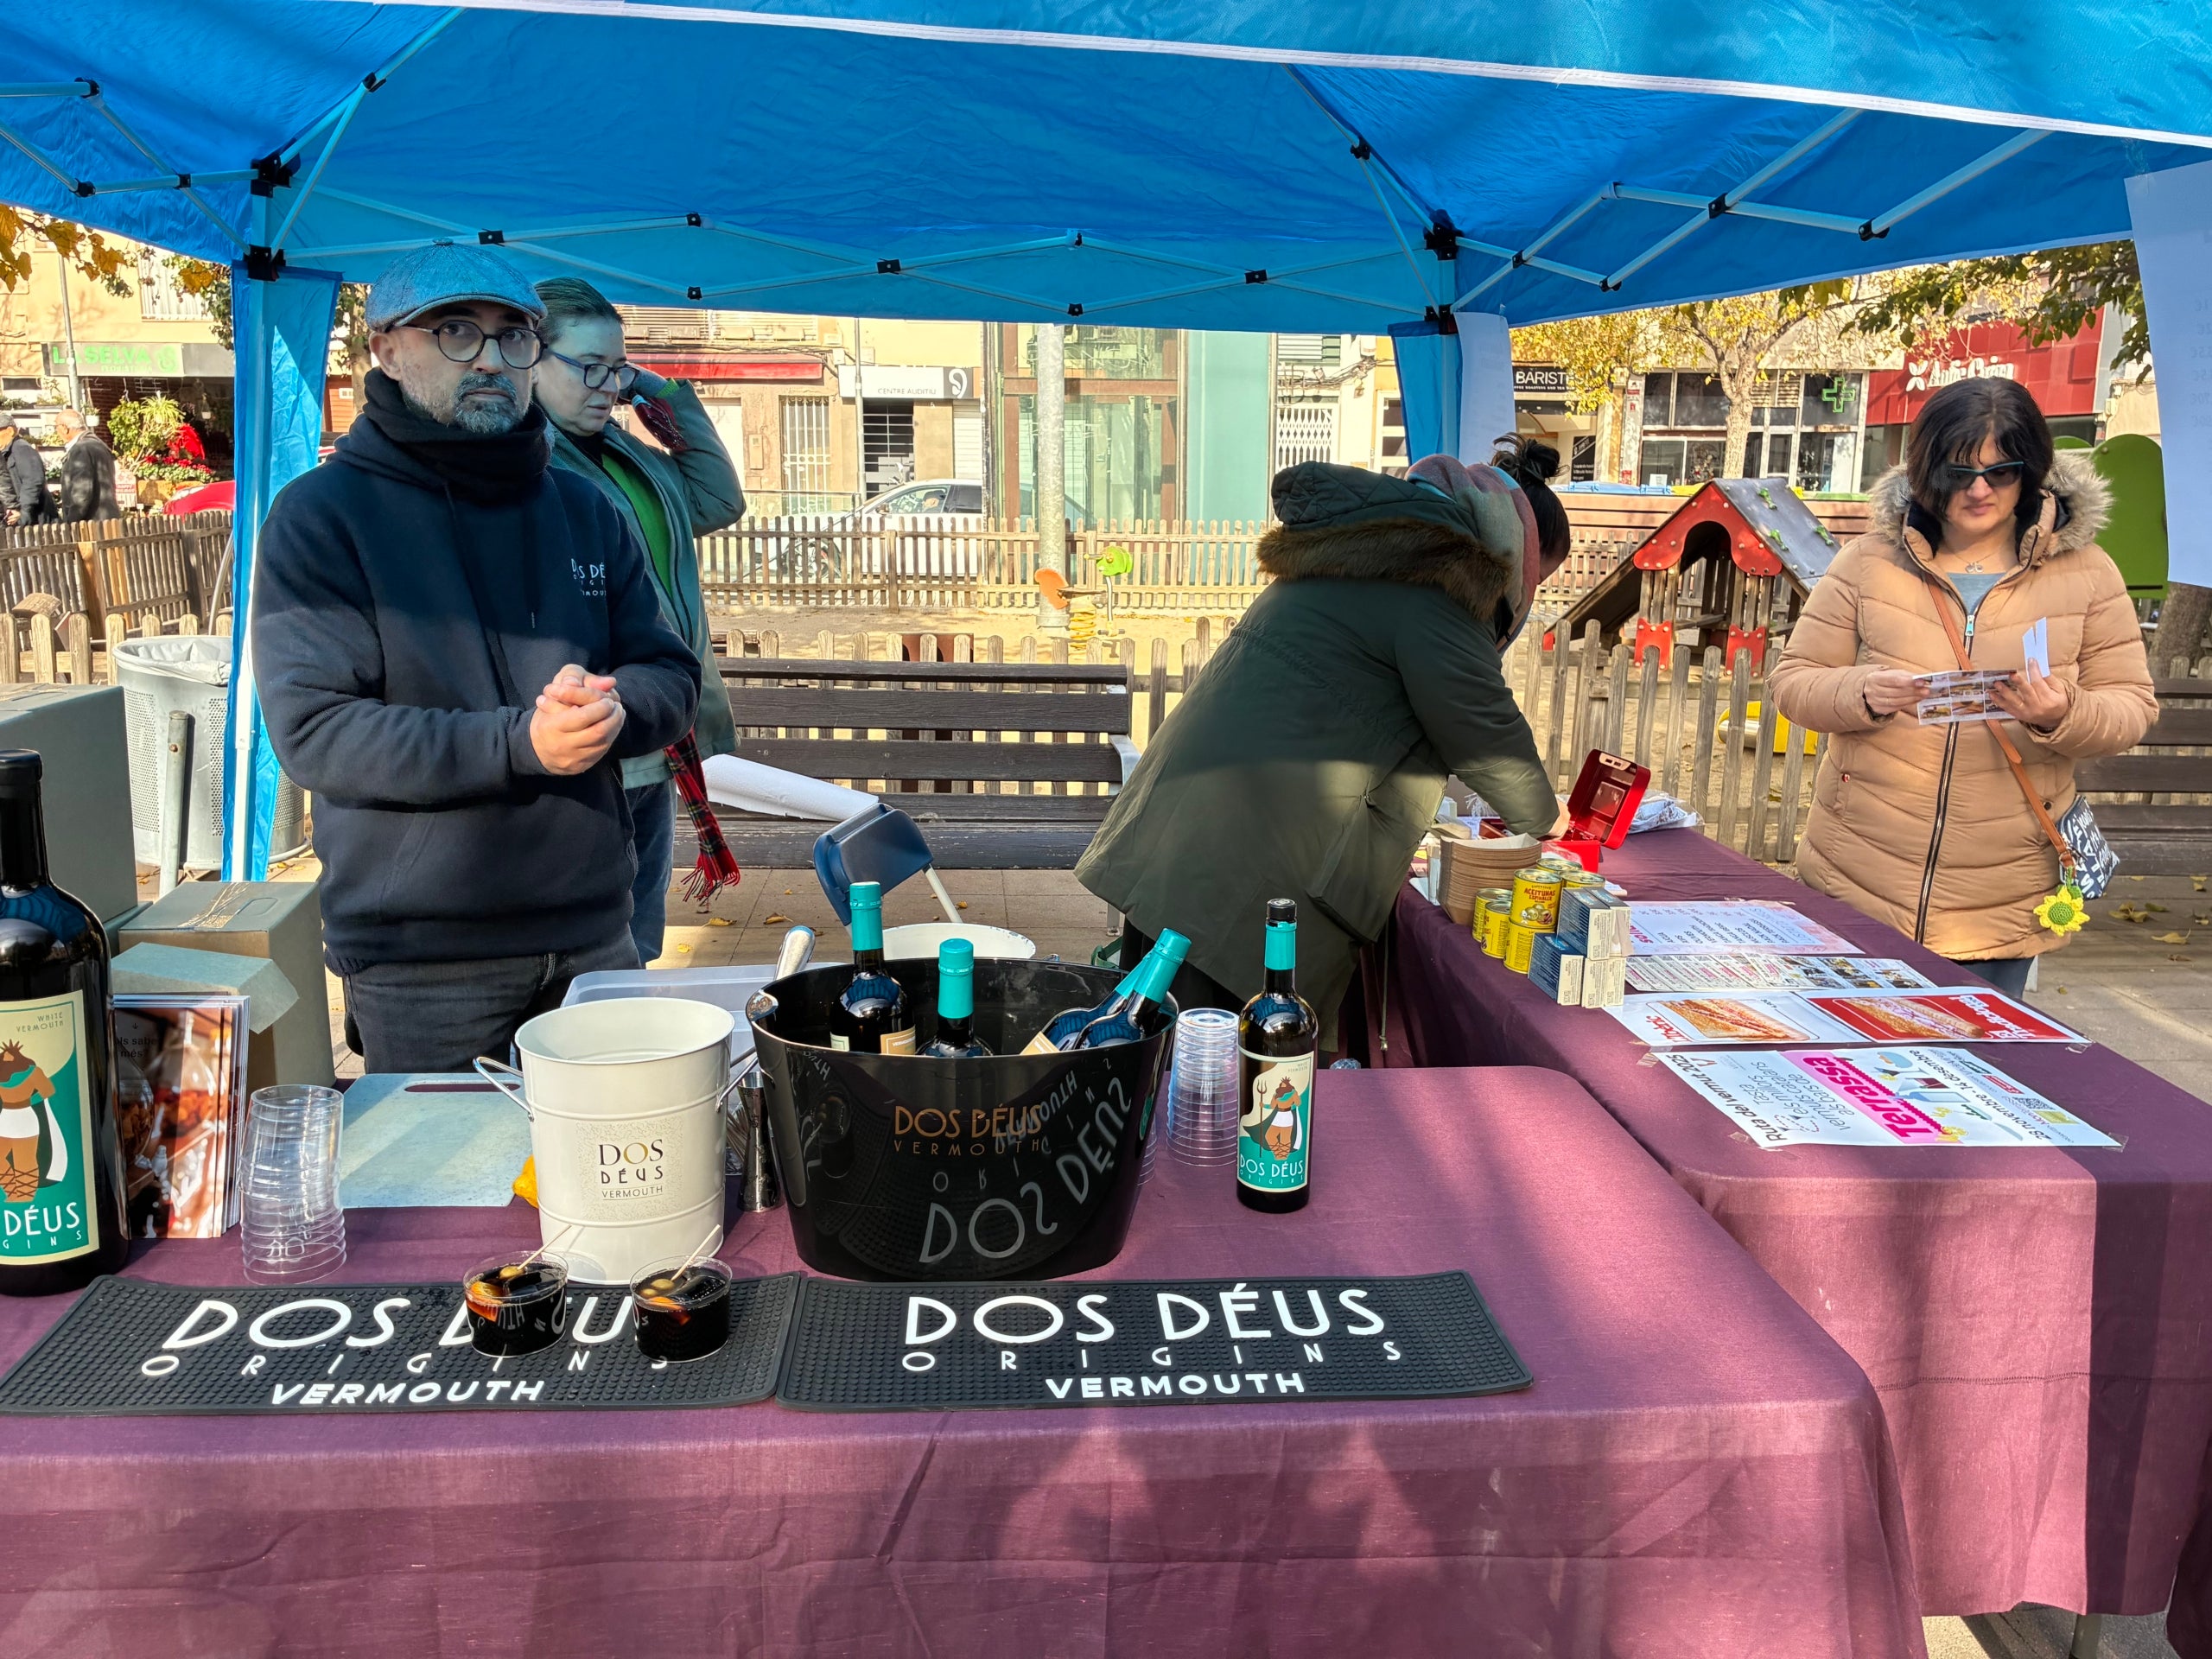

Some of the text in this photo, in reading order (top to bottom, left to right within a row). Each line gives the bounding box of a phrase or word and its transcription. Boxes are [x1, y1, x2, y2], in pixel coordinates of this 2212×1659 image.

[86, 346, 151, 364] SELVA
[571, 558, 606, 578] DS DÉ
[16, 1020, 64, 1033] VERMOUTH
[38, 1011, 63, 1021] WHITE
[1751, 1061, 1802, 1094] catalans
[1910, 1050, 1961, 1079] desembre
[1666, 1054, 1788, 1141] Ruta del vermut 2025
[1738, 1084, 1774, 1105] Tasta
[1747, 1075, 1808, 1115] els millors
[1787, 1073, 1855, 1116] als bars de
[1802, 1057, 1933, 1137] Terrassa
[1955, 1081, 1968, 1090] 14
[895, 1103, 1042, 1138] DOS DÉUS
[1795, 1094, 1851, 1130] vermuts
[1976, 1094, 2035, 1129] novembre
[894, 1139, 1039, 1157] VERMOUTH
[2029, 1130, 2052, 1140] 28
[598, 1139, 664, 1166] DOS
[1240, 1154, 1304, 1178] DOS DÉUS
[601, 1166, 664, 1184] DÉUS
[1240, 1169, 1304, 1185] ORIGINS
[602, 1185, 663, 1198] VERMOUTH
[4, 1202, 80, 1236] DÉUS
[2, 1230, 82, 1249] GINS
[162, 1298, 412, 1348] DOS
[905, 1283, 1384, 1345] DOS DÉUS
[902, 1341, 1401, 1371] ORIGINS
[270, 1380, 548, 1406] VERMOUTH
[1045, 1372, 1305, 1399] VERMOUTH
